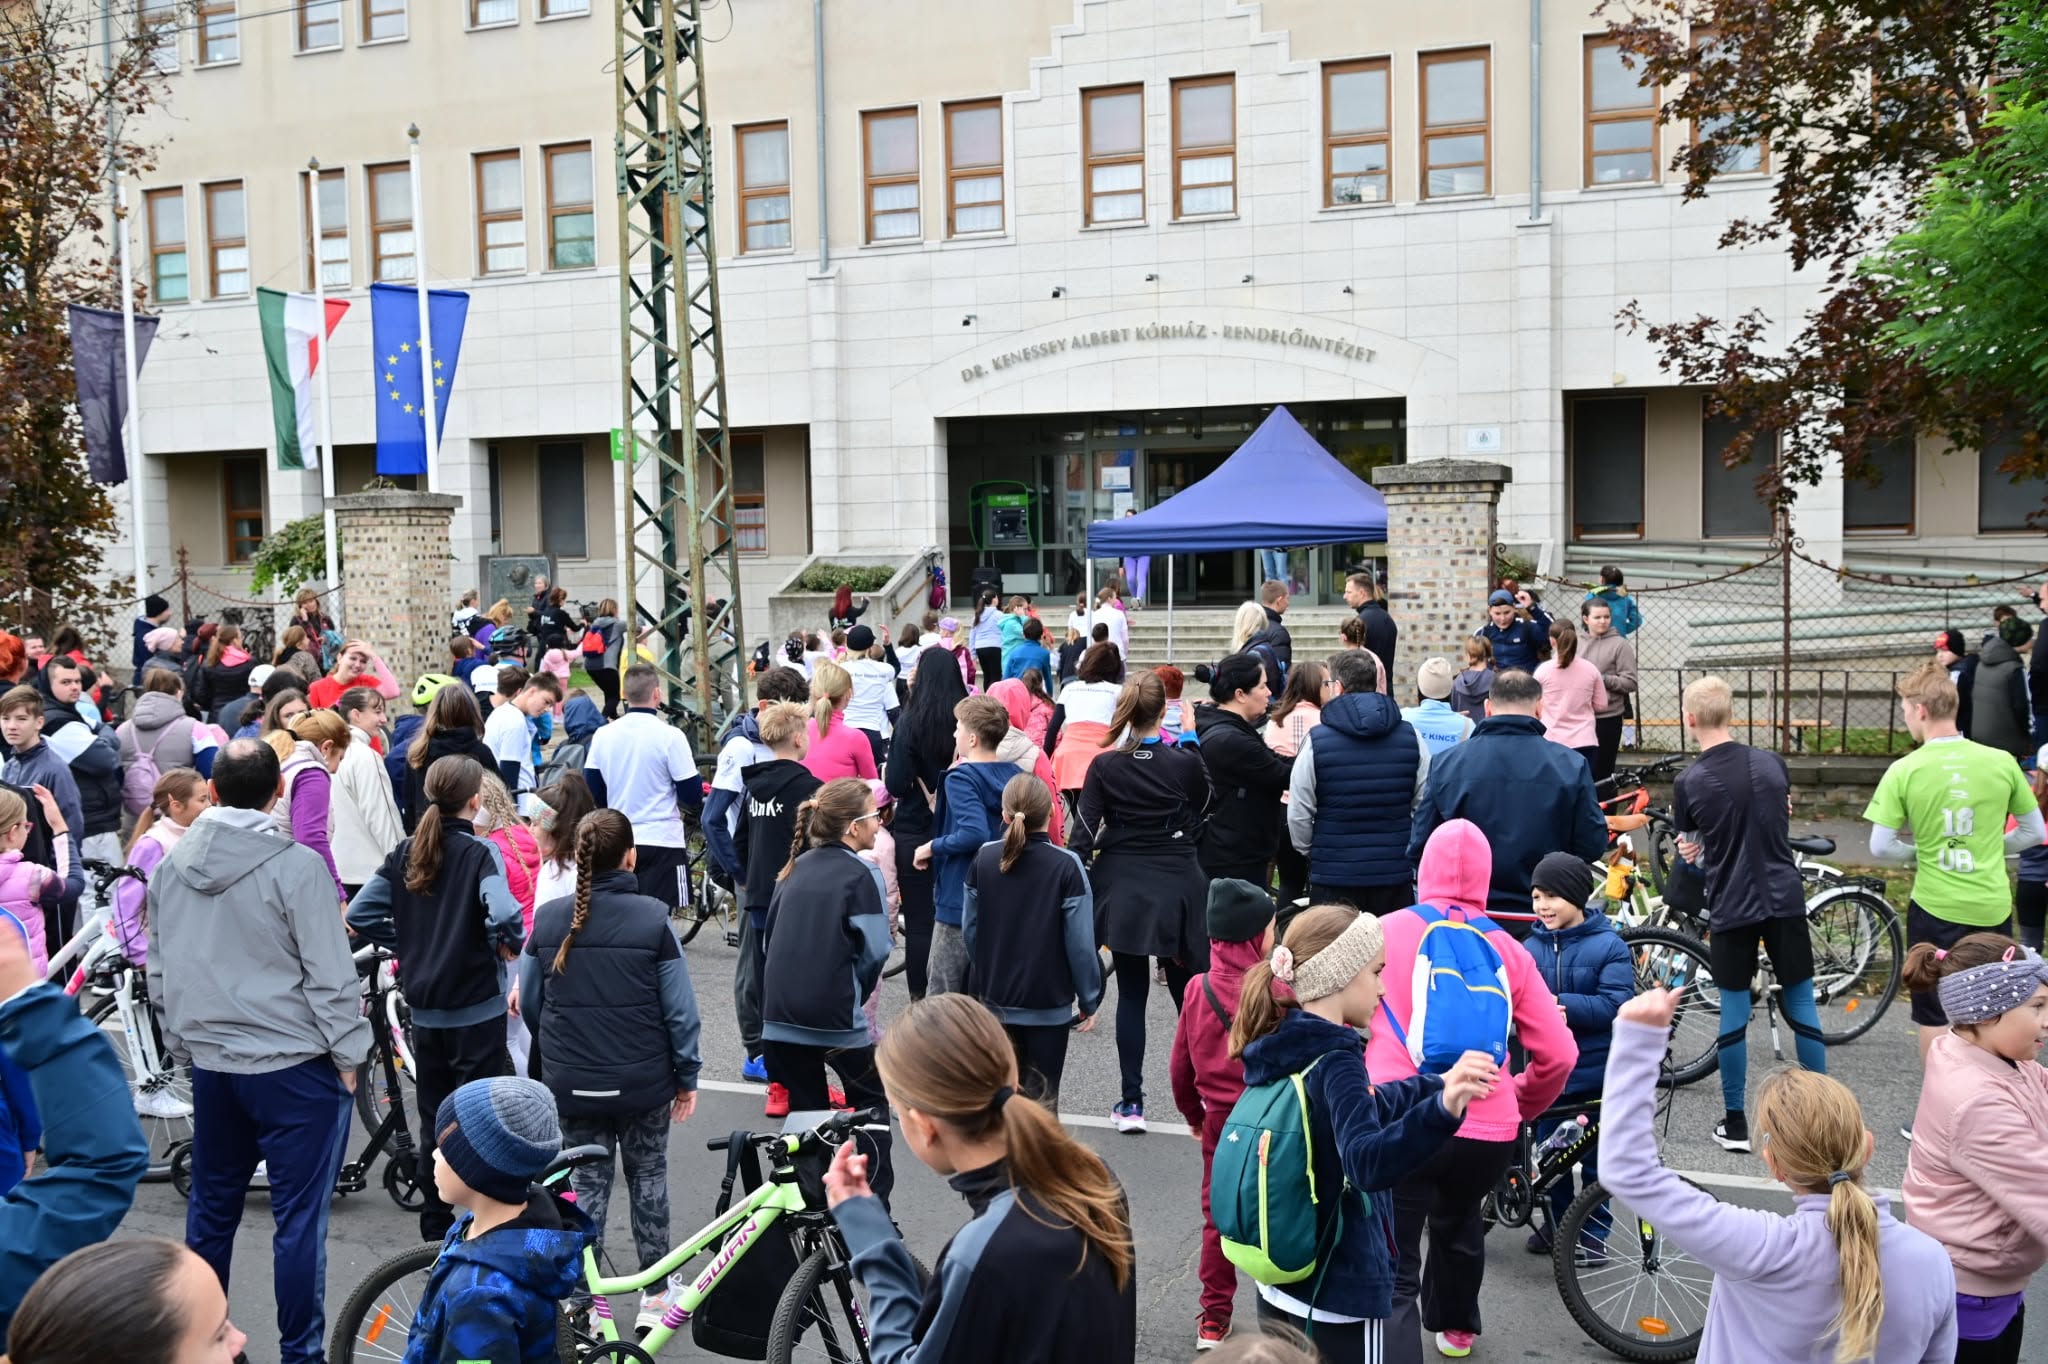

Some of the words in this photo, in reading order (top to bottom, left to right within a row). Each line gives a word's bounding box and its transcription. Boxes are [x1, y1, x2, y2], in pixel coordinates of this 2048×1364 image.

[961, 364, 989, 383] DR.
[991, 338, 1067, 371] KENESSEY
[1071, 328, 1131, 349] ALBERT
[1135, 320, 1208, 342] KÓRHÁZ
[1223, 325, 1376, 363] RENDELŐINTÉZET
[697, 1219, 757, 1294] SWAN
